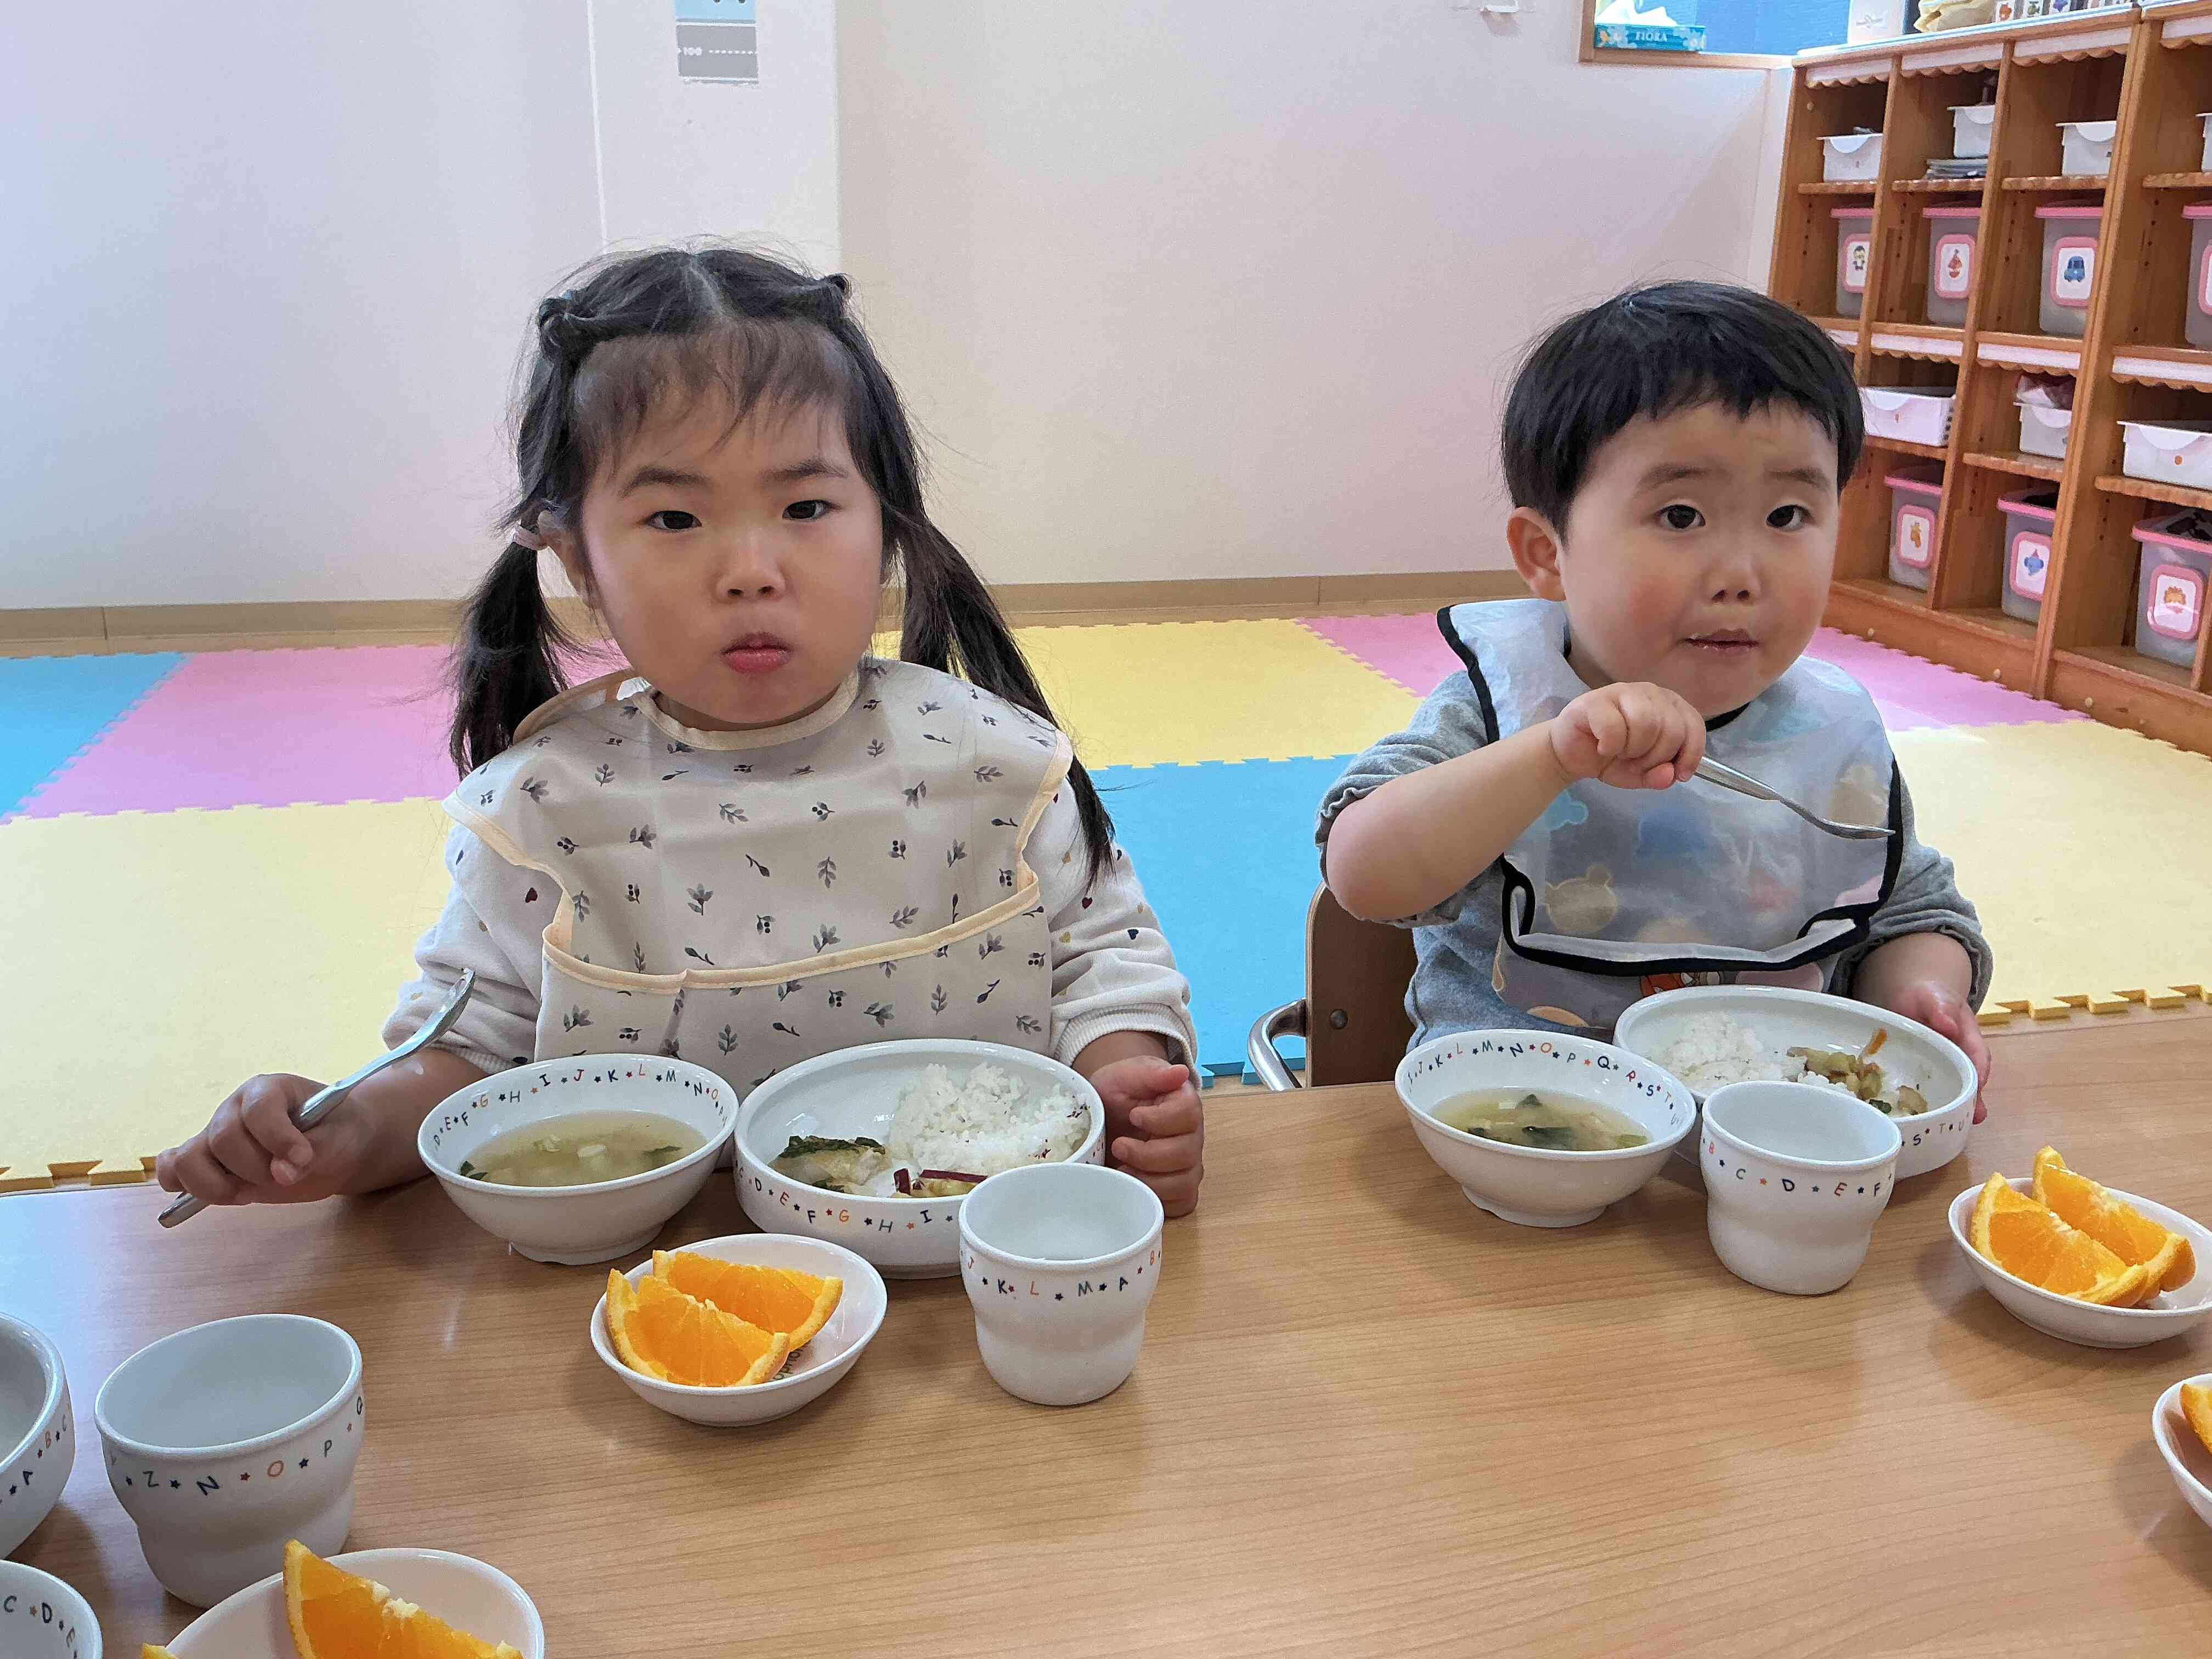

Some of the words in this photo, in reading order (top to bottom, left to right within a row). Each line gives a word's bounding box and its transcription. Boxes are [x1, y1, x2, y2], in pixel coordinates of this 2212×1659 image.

[1418, 1061, 1423, 1074] J
[1435, 1053, 1443, 1068] K
[1457, 1042, 1463, 1054] L
[1482, 1039, 1493, 1052] M
[1510, 1042, 1523, 1058] N
[1540, 1042, 1553, 1053] O
[1566, 1052, 1576, 1063] P
[1597, 1055, 1611, 1070] Q
[1625, 1070, 1636, 1082] R
[1646, 1084, 1654, 1096] S
[444, 1116, 452, 1130] E
[461, 1111, 469, 1127] F
[480, 1093, 488, 1107] G
[509, 1090, 521, 1103] H
[539, 1073, 551, 1087] I
[573, 1069, 585, 1081] J
[607, 1069, 619, 1082] K
[638, 1063, 646, 1076] L
[665, 1069, 676, 1082] M
[693, 1081, 703, 1097] N
[711, 1088, 718, 1100] O
[1912, 1133, 1922, 1147] S
[1939, 1122, 1946, 1134] T
[1736, 1168, 1747, 1180] C
[1781, 1178, 1795, 1192] D
[1833, 1182, 1848, 1197] E
[1874, 1182, 1881, 1197] F
[754, 1177, 762, 1192] D
[779, 1191, 790, 1206] E
[807, 1210, 816, 1224] F
[839, 1209, 850, 1223] G
[878, 1218, 894, 1234] H
[919, 1209, 933, 1224] I
[997, 1278, 1008, 1295] K
[1030, 1280, 1040, 1295] L
[1077, 1280, 1093, 1297] M
[1119, 1276, 1128, 1292] A
[142, 1470, 160, 1488] Z
[196, 1475, 220, 1497] N
[267, 1460, 284, 1477] O
[324, 1440, 332, 1458] P
[3, 1595, 18, 1613] C
[41, 1601, 53, 1624] D
